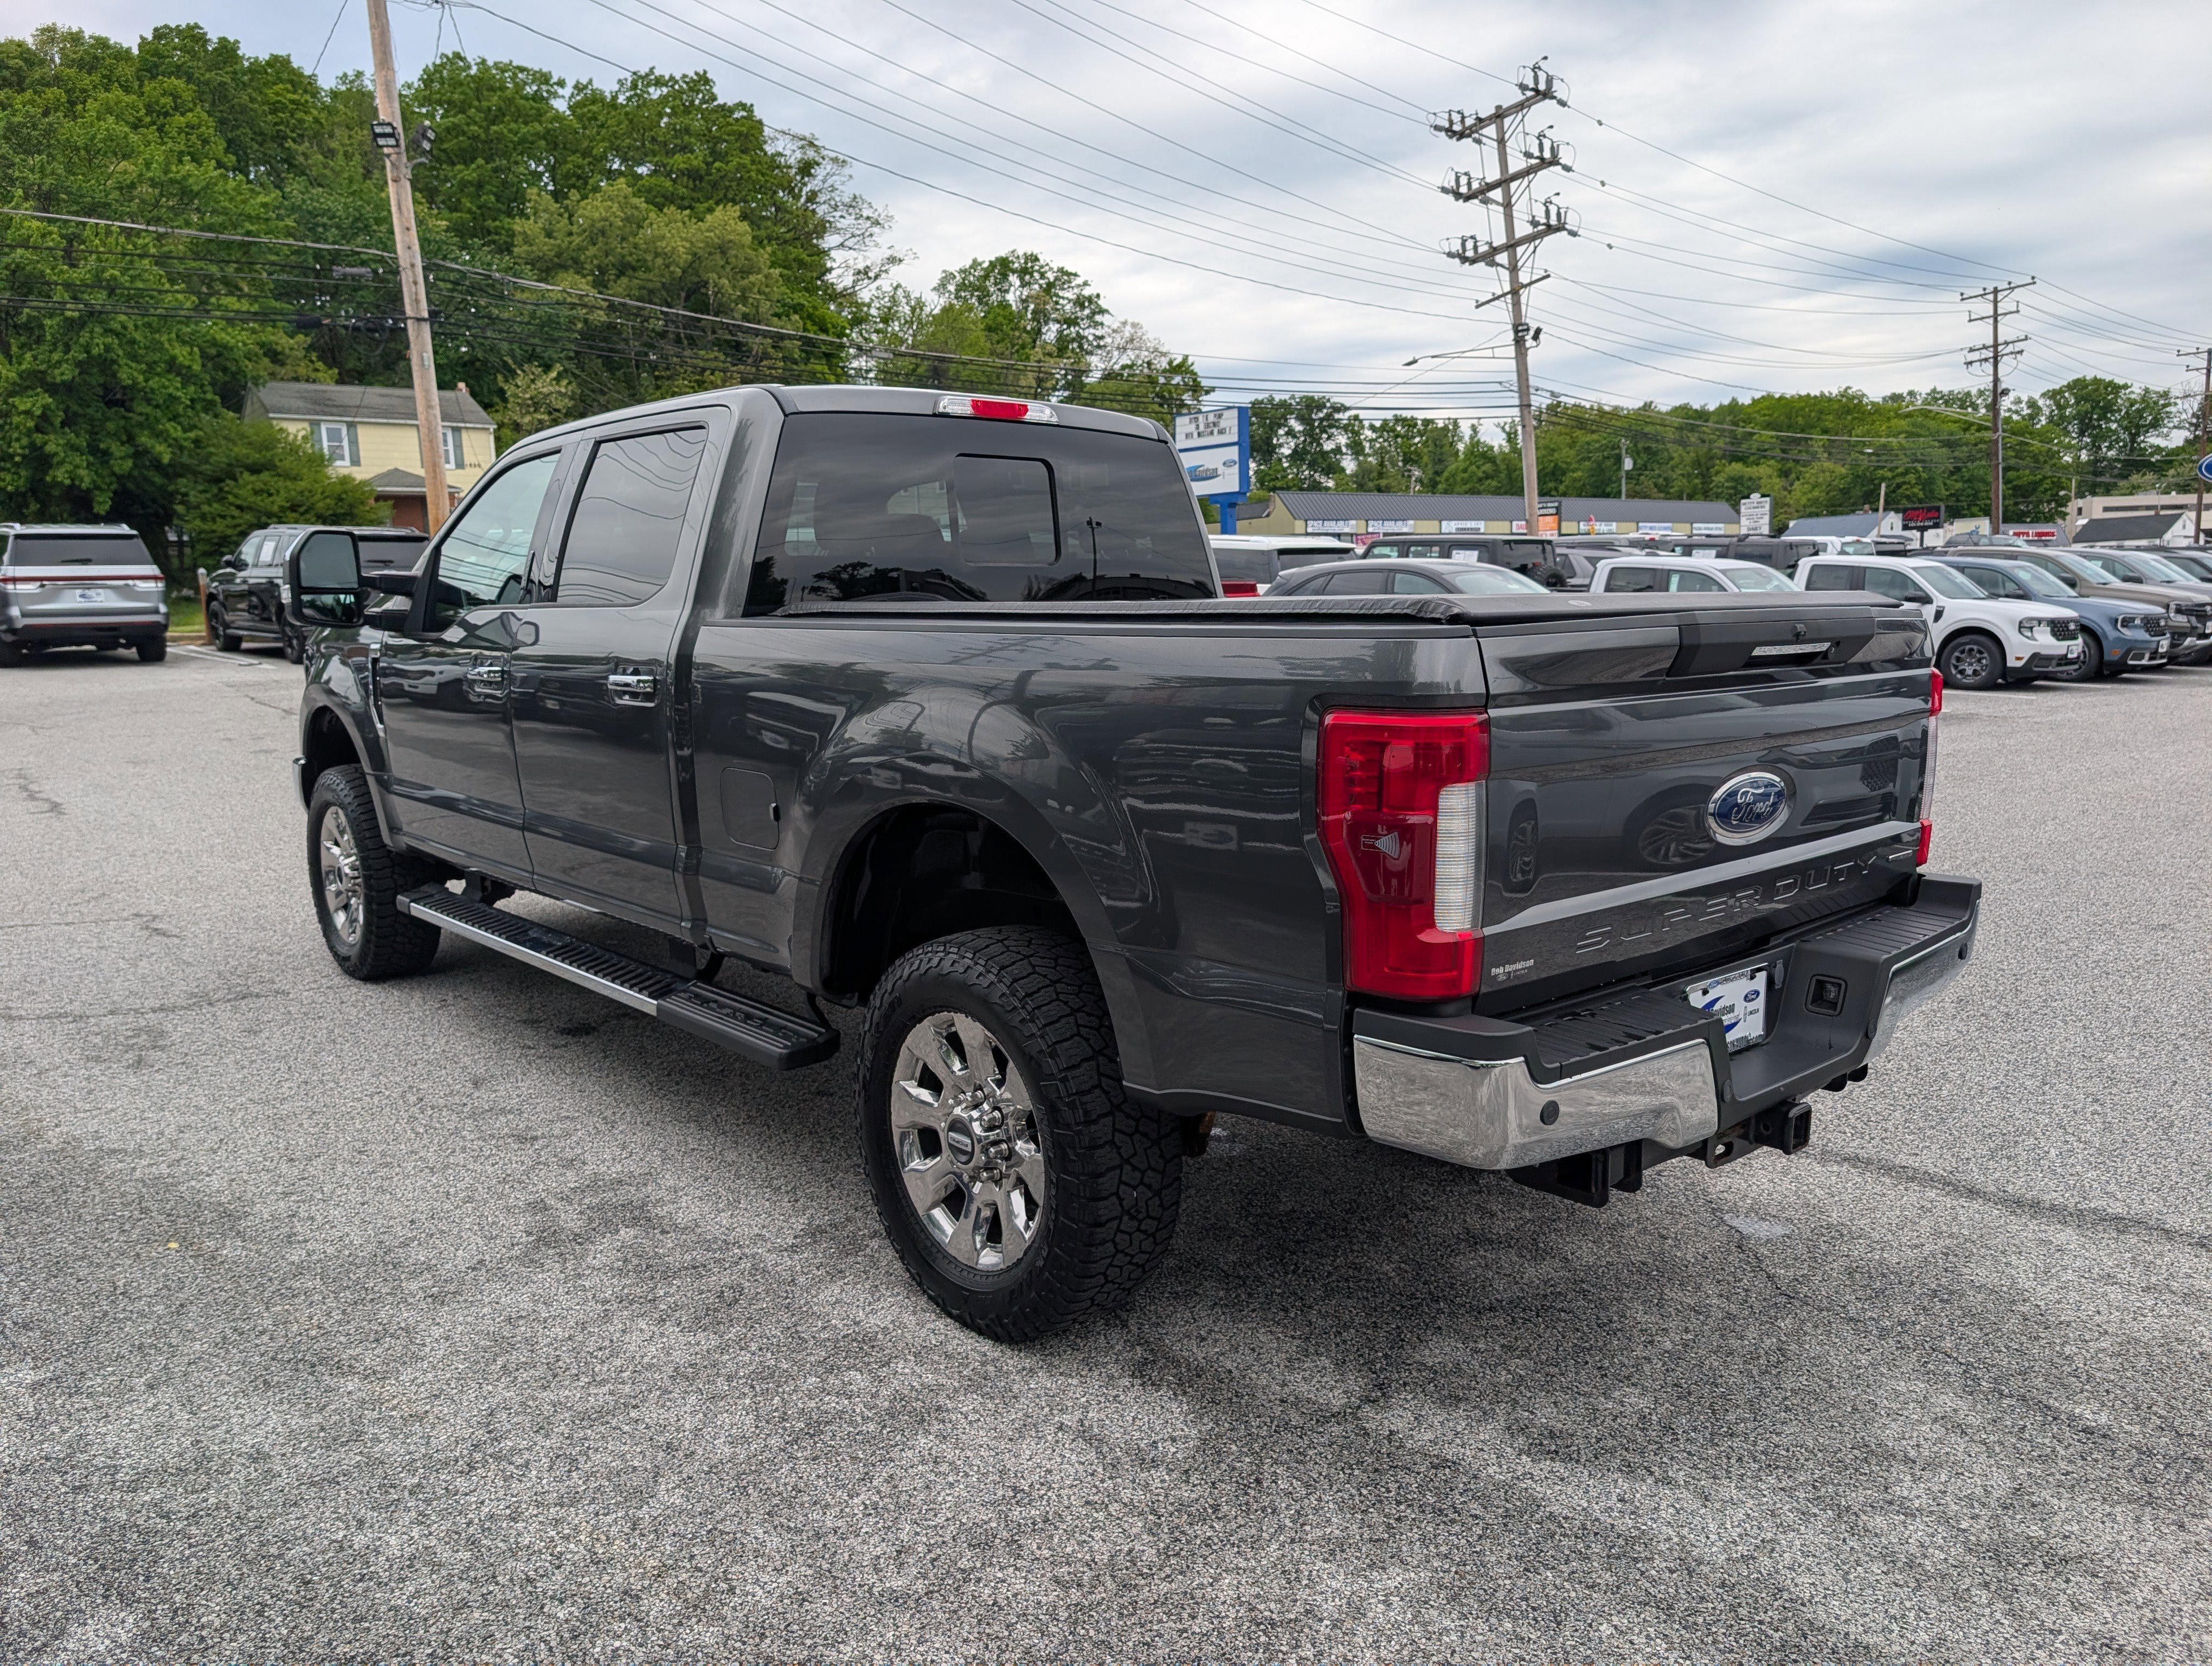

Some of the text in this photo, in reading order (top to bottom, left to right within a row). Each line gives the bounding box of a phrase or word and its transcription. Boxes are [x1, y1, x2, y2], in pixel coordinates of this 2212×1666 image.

[1576, 855, 1877, 954] SUPER DUTY
[1491, 959, 1534, 976] Bob Davidson
